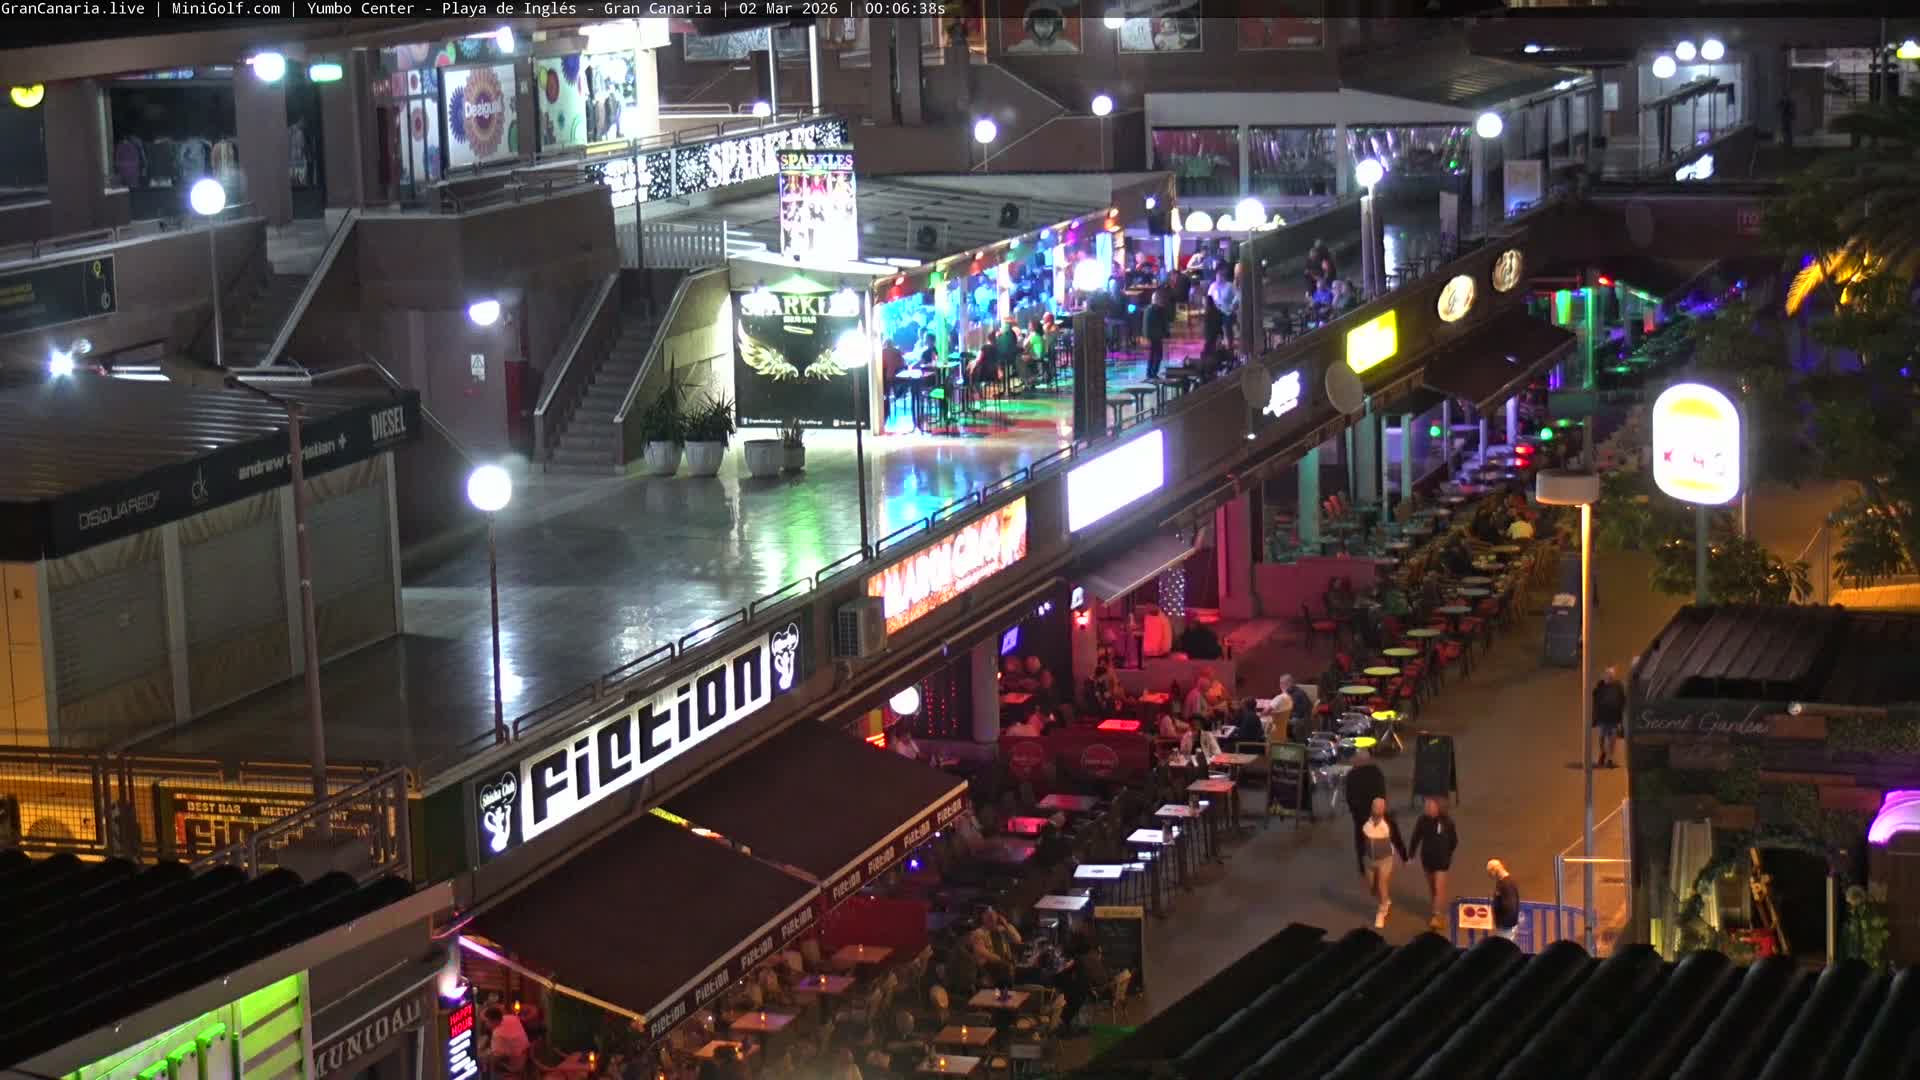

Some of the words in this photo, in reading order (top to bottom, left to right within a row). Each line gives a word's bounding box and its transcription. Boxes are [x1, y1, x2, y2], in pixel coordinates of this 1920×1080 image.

[781, 153, 854, 168] SPARKLES
[740, 292, 859, 316] SARKL
[370, 404, 407, 441] DIESEL
[238, 454, 284, 481] andrew
[287, 439, 336, 465] cristian
[1638, 709, 1690, 729] Secret
[186, 801, 215, 812] BEST
[218, 803, 241, 814] BAR
[450, 1004, 473, 1025] HAPPY
[451, 1016, 473, 1037] HOUR
